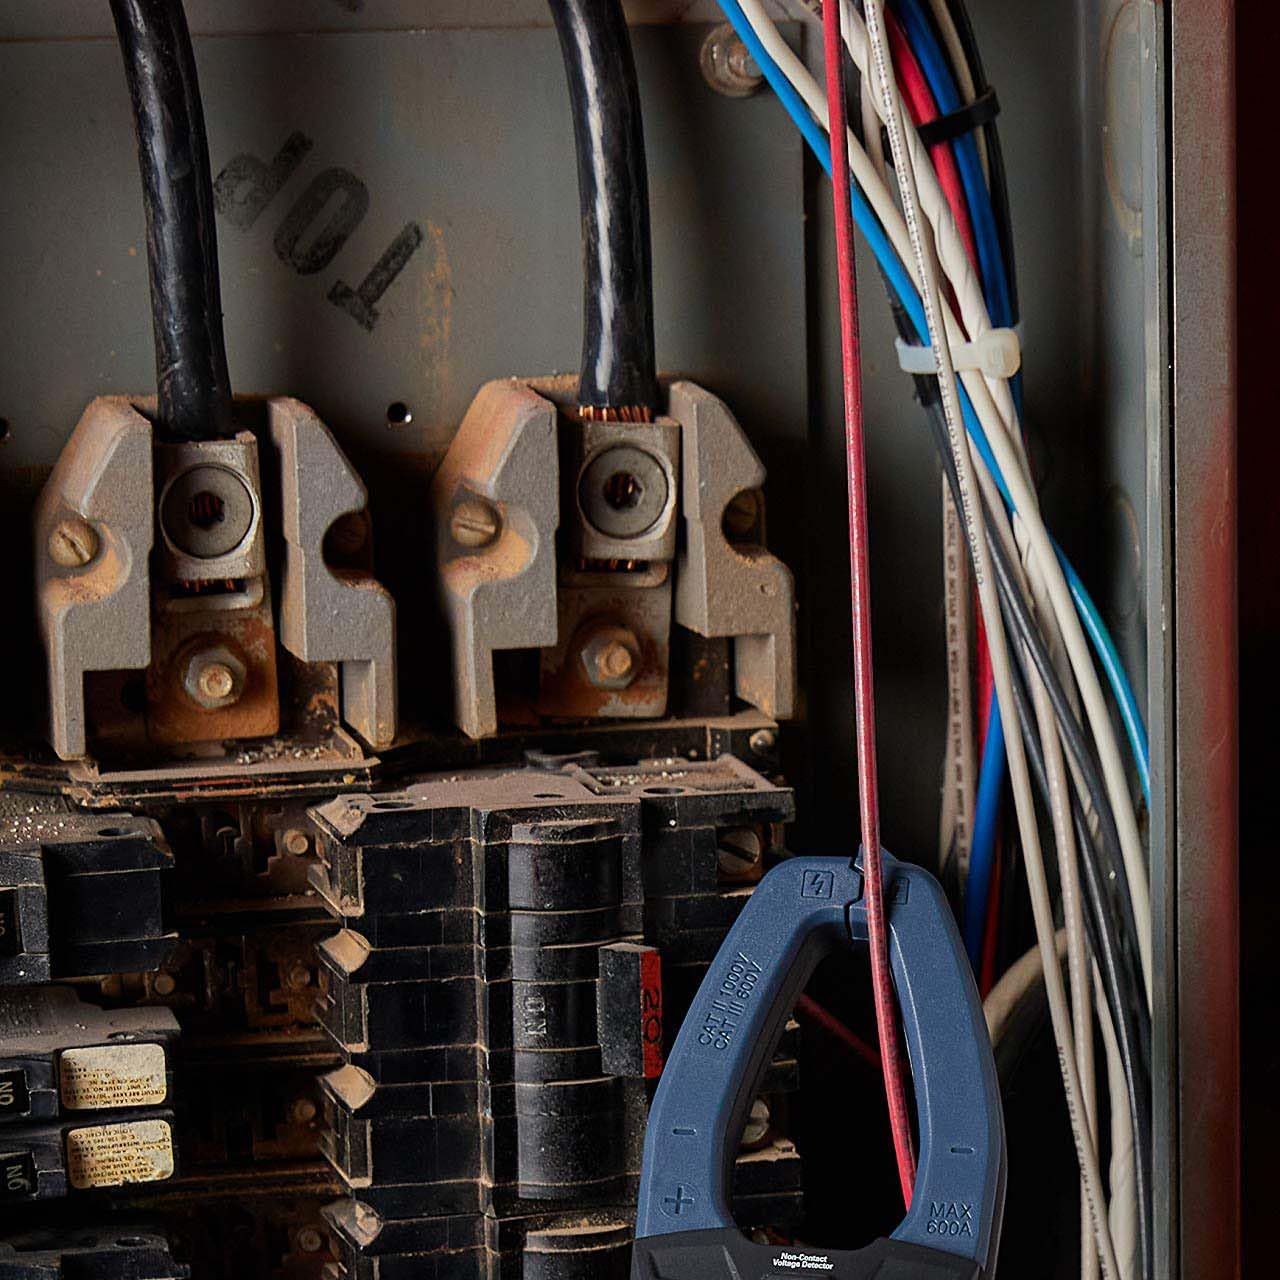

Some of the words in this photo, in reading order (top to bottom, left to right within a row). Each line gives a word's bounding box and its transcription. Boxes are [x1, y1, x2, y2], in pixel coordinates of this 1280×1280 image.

[213, 130, 424, 332] TOP
[960, 487, 974, 526] WIRE
[967, 531, 985, 586] CERRO
[698, 1012, 720, 1045] CAT
[712, 1000, 728, 1011] II
[720, 951, 749, 997] 1000V
[714, 1018, 736, 1050] CAT
[728, 1001, 744, 1016] III
[737, 960, 762, 999] 600V
[643, 988, 660, 1042] 20
[0, 1080, 14, 1106] ON
[6, 1164, 28, 1191] ON
[929, 1202, 973, 1219] MAX
[927, 1219, 974, 1237] 600A
[773, 1258, 801, 1268] Voltage
[801, 1261, 834, 1270] Detector
[781, 1252, 828, 1262] Non-Contact
